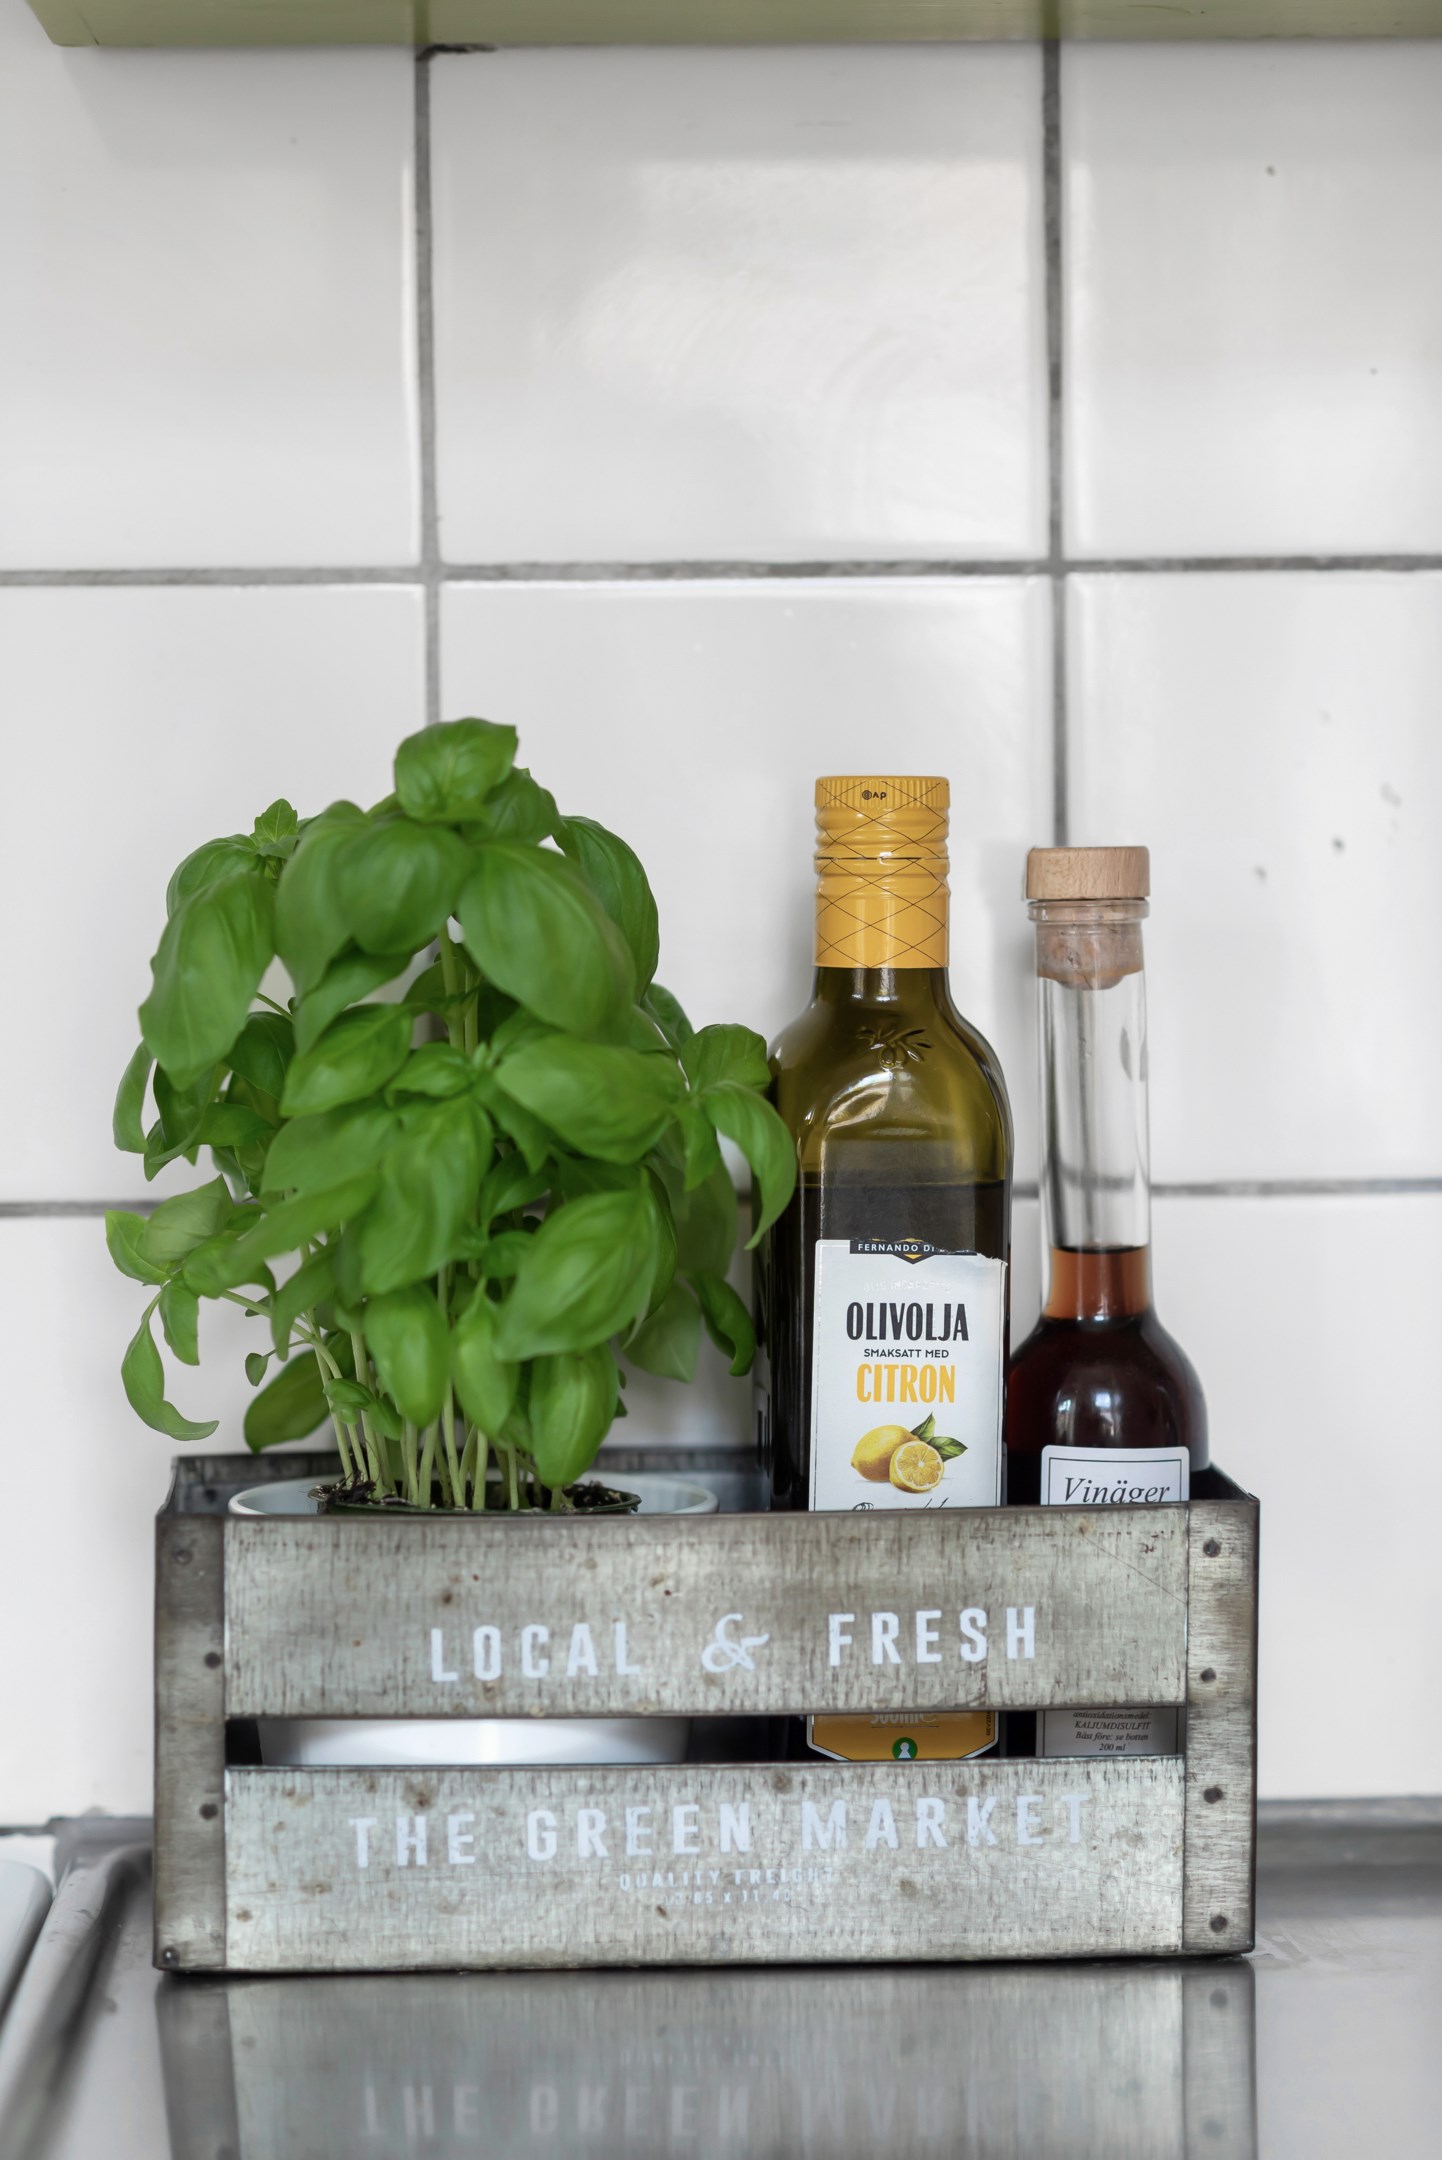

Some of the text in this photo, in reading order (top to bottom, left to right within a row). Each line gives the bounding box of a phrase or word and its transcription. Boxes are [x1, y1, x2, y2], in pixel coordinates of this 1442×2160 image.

[858, 1243, 919, 1252] FERNANDO
[847, 1302, 969, 1342] OLIVOLJA
[863, 1348, 949, 1359] SMAKSATT MED
[856, 1363, 956, 1403] CITRON
[1064, 1476, 1171, 1503] Vinäger
[431, 1606, 1036, 1682] LOCAL & FRESH
[1075, 1731, 1093, 1740] Bäst
[1125, 1732, 1149, 1741] botten
[1099, 1743, 1126, 1751] 200 ml
[348, 1793, 1090, 1867] THE GREEN MARKET
[619, 1869, 721, 1891] QUALITY
